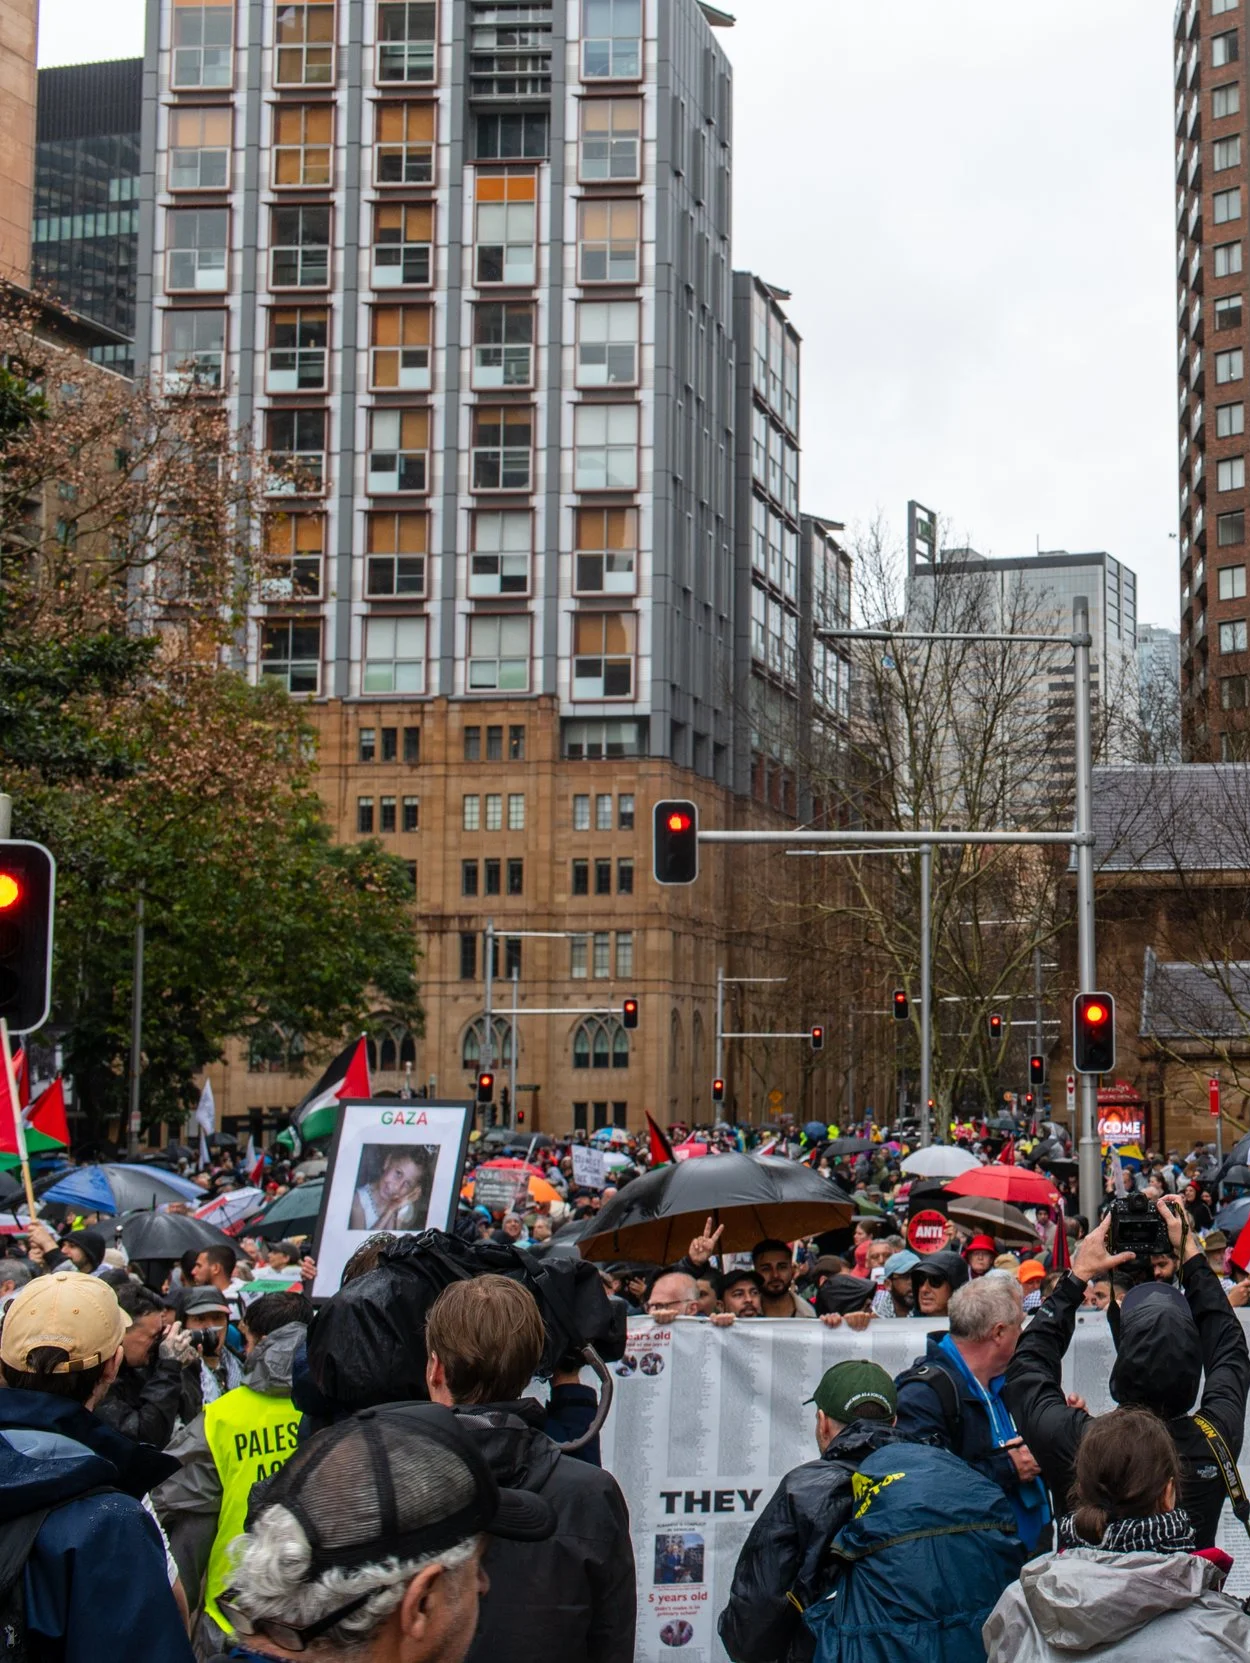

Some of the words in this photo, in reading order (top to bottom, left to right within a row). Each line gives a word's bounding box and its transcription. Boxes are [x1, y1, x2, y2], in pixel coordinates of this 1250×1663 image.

[381, 1111, 427, 1125] GAZA
[1103, 1121, 1140, 1134] COME
[915, 1226, 942, 1238] ANTI
[626, 1332, 650, 1340] ears
[654, 1331, 671, 1340] old
[1223, 1461, 1238, 1487] NPS
[660, 1488, 763, 1514] THEY
[648, 1593, 655, 1603] 5
[658, 1594, 688, 1604] years
[691, 1591, 708, 1601] old
